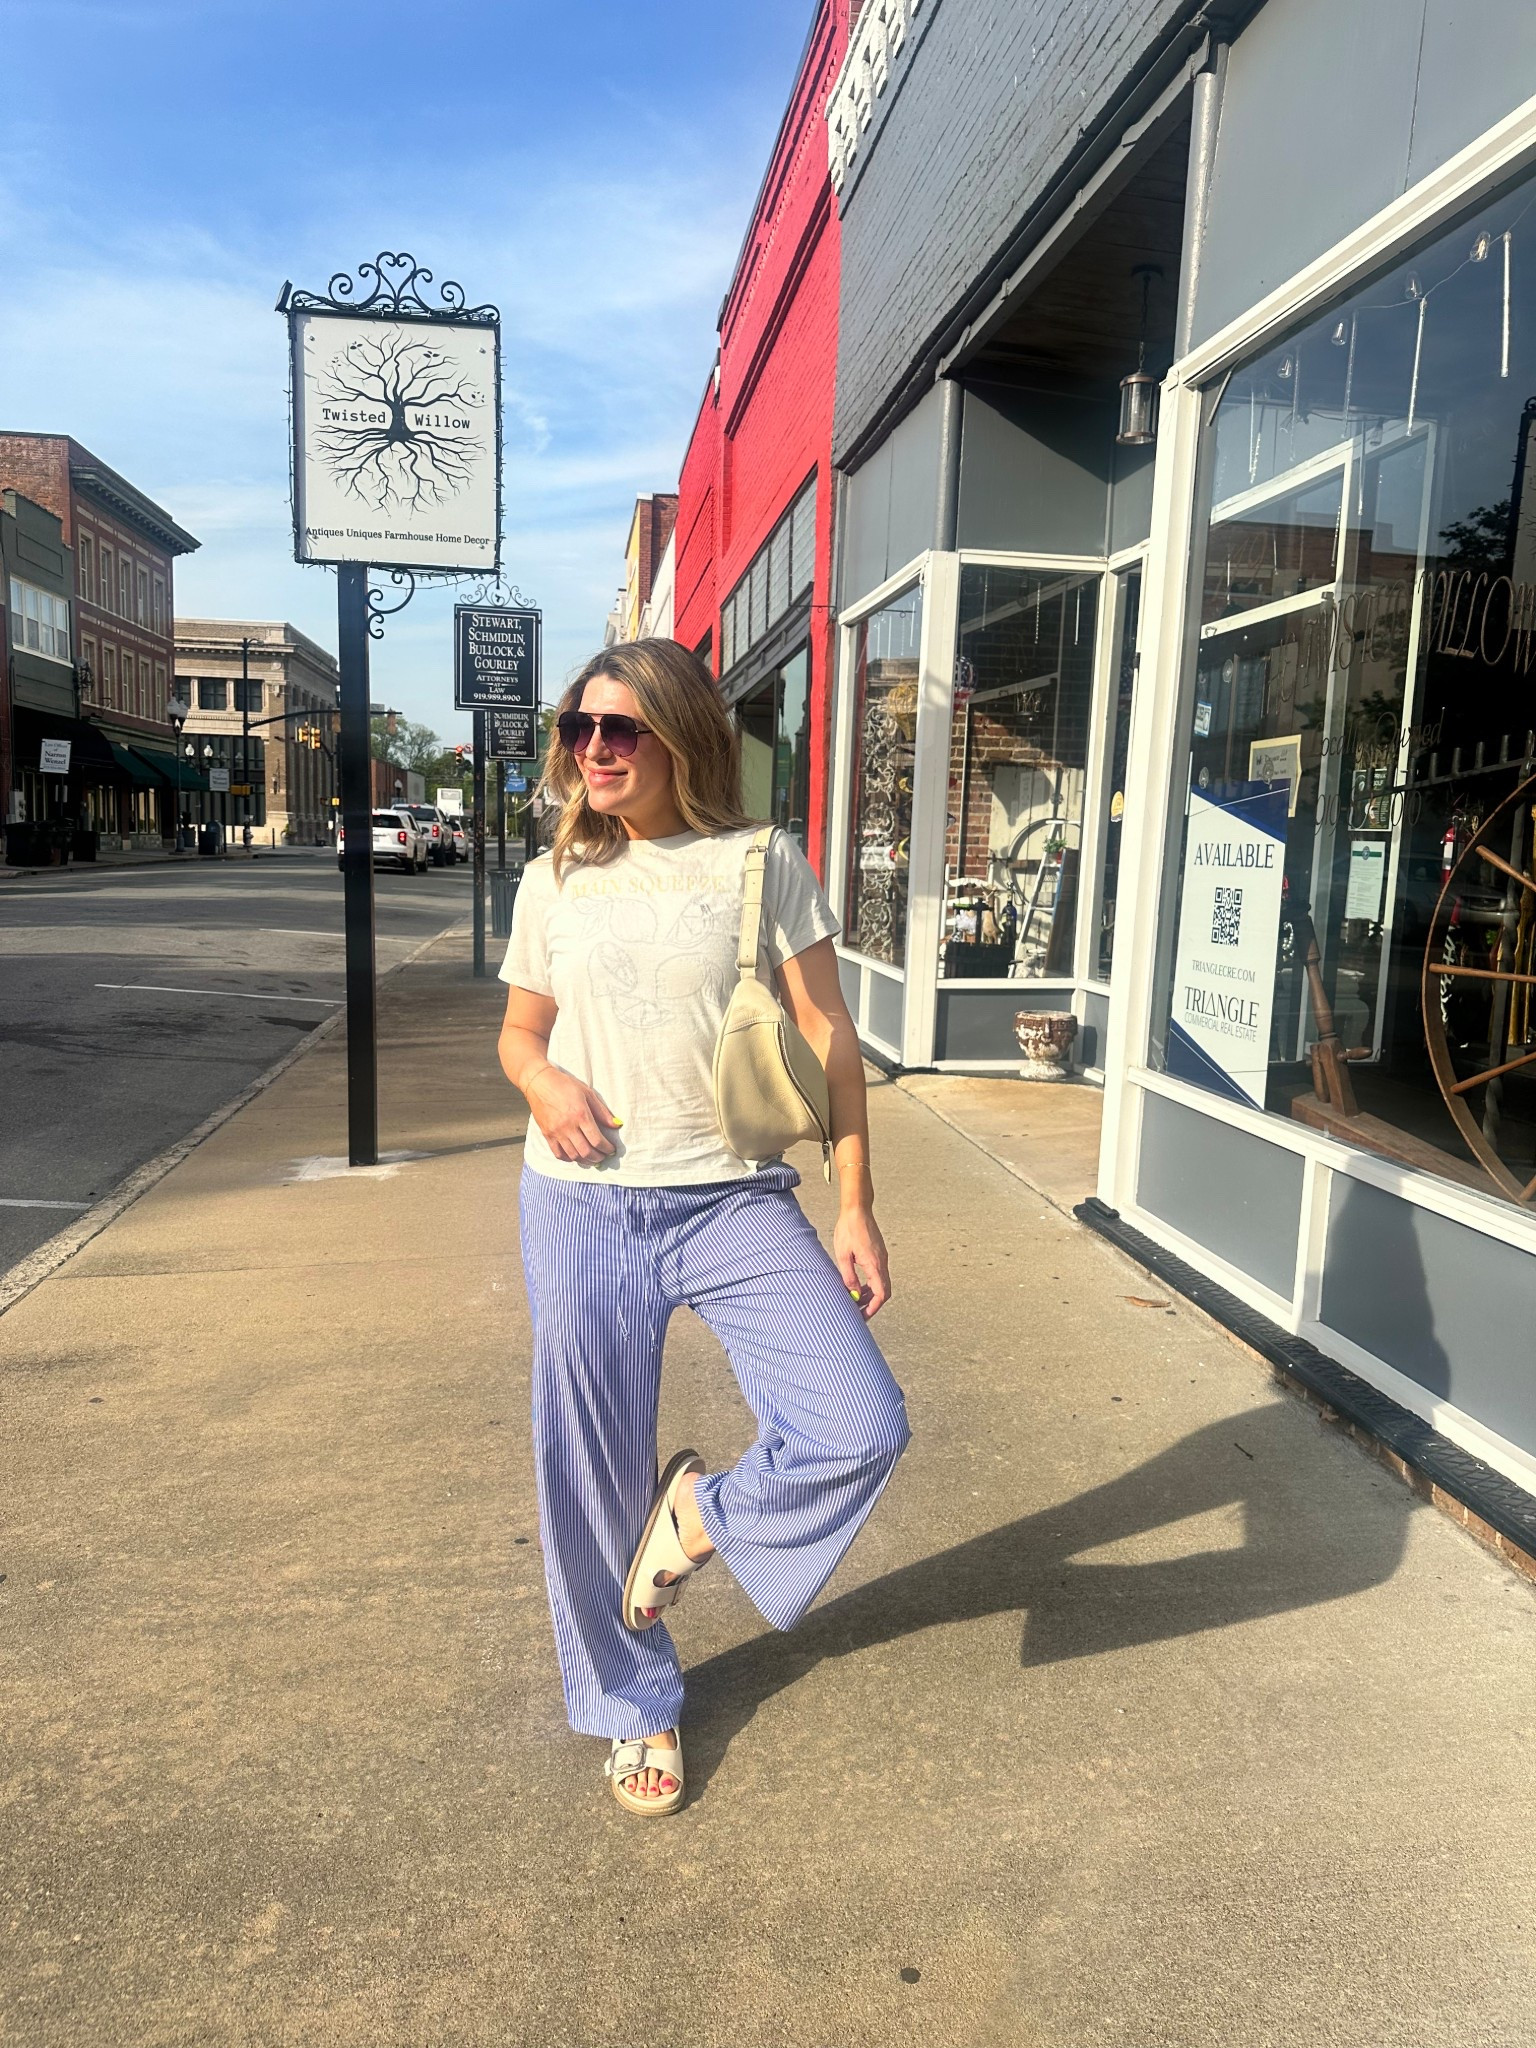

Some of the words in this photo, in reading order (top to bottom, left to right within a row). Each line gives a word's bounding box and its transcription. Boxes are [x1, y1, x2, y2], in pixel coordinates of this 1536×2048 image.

[322, 408, 386, 423] Twisted
[415, 413, 471, 429] Willow
[305, 527, 344, 538] Antiques
[346, 528, 382, 540] Uniques
[384, 530, 433, 541] Farmhouse
[436, 533, 461, 543] Home
[464, 534, 489, 544] Decor
[472, 613, 522, 630] STEWART,
[468, 627, 526, 645] SCHMIDLIN,
[474, 656, 519, 670] GOURLEY
[476, 674, 518, 683] ATTORNEYS
[473, 693, 521, 701] 919.989.8900
[1194, 843, 1275, 868] AVAILABLE
[571, 879, 622, 897] MAIN
[1192, 959, 1256, 983] TRIANGLECRE.COM
[1184, 986, 1260, 1028] TRIANGLE
[1184, 1011, 1219, 1032] COMMERCIAL
[1220, 1021, 1234, 1037] REAL
[1235, 1025, 1257, 1042] ESTATE
